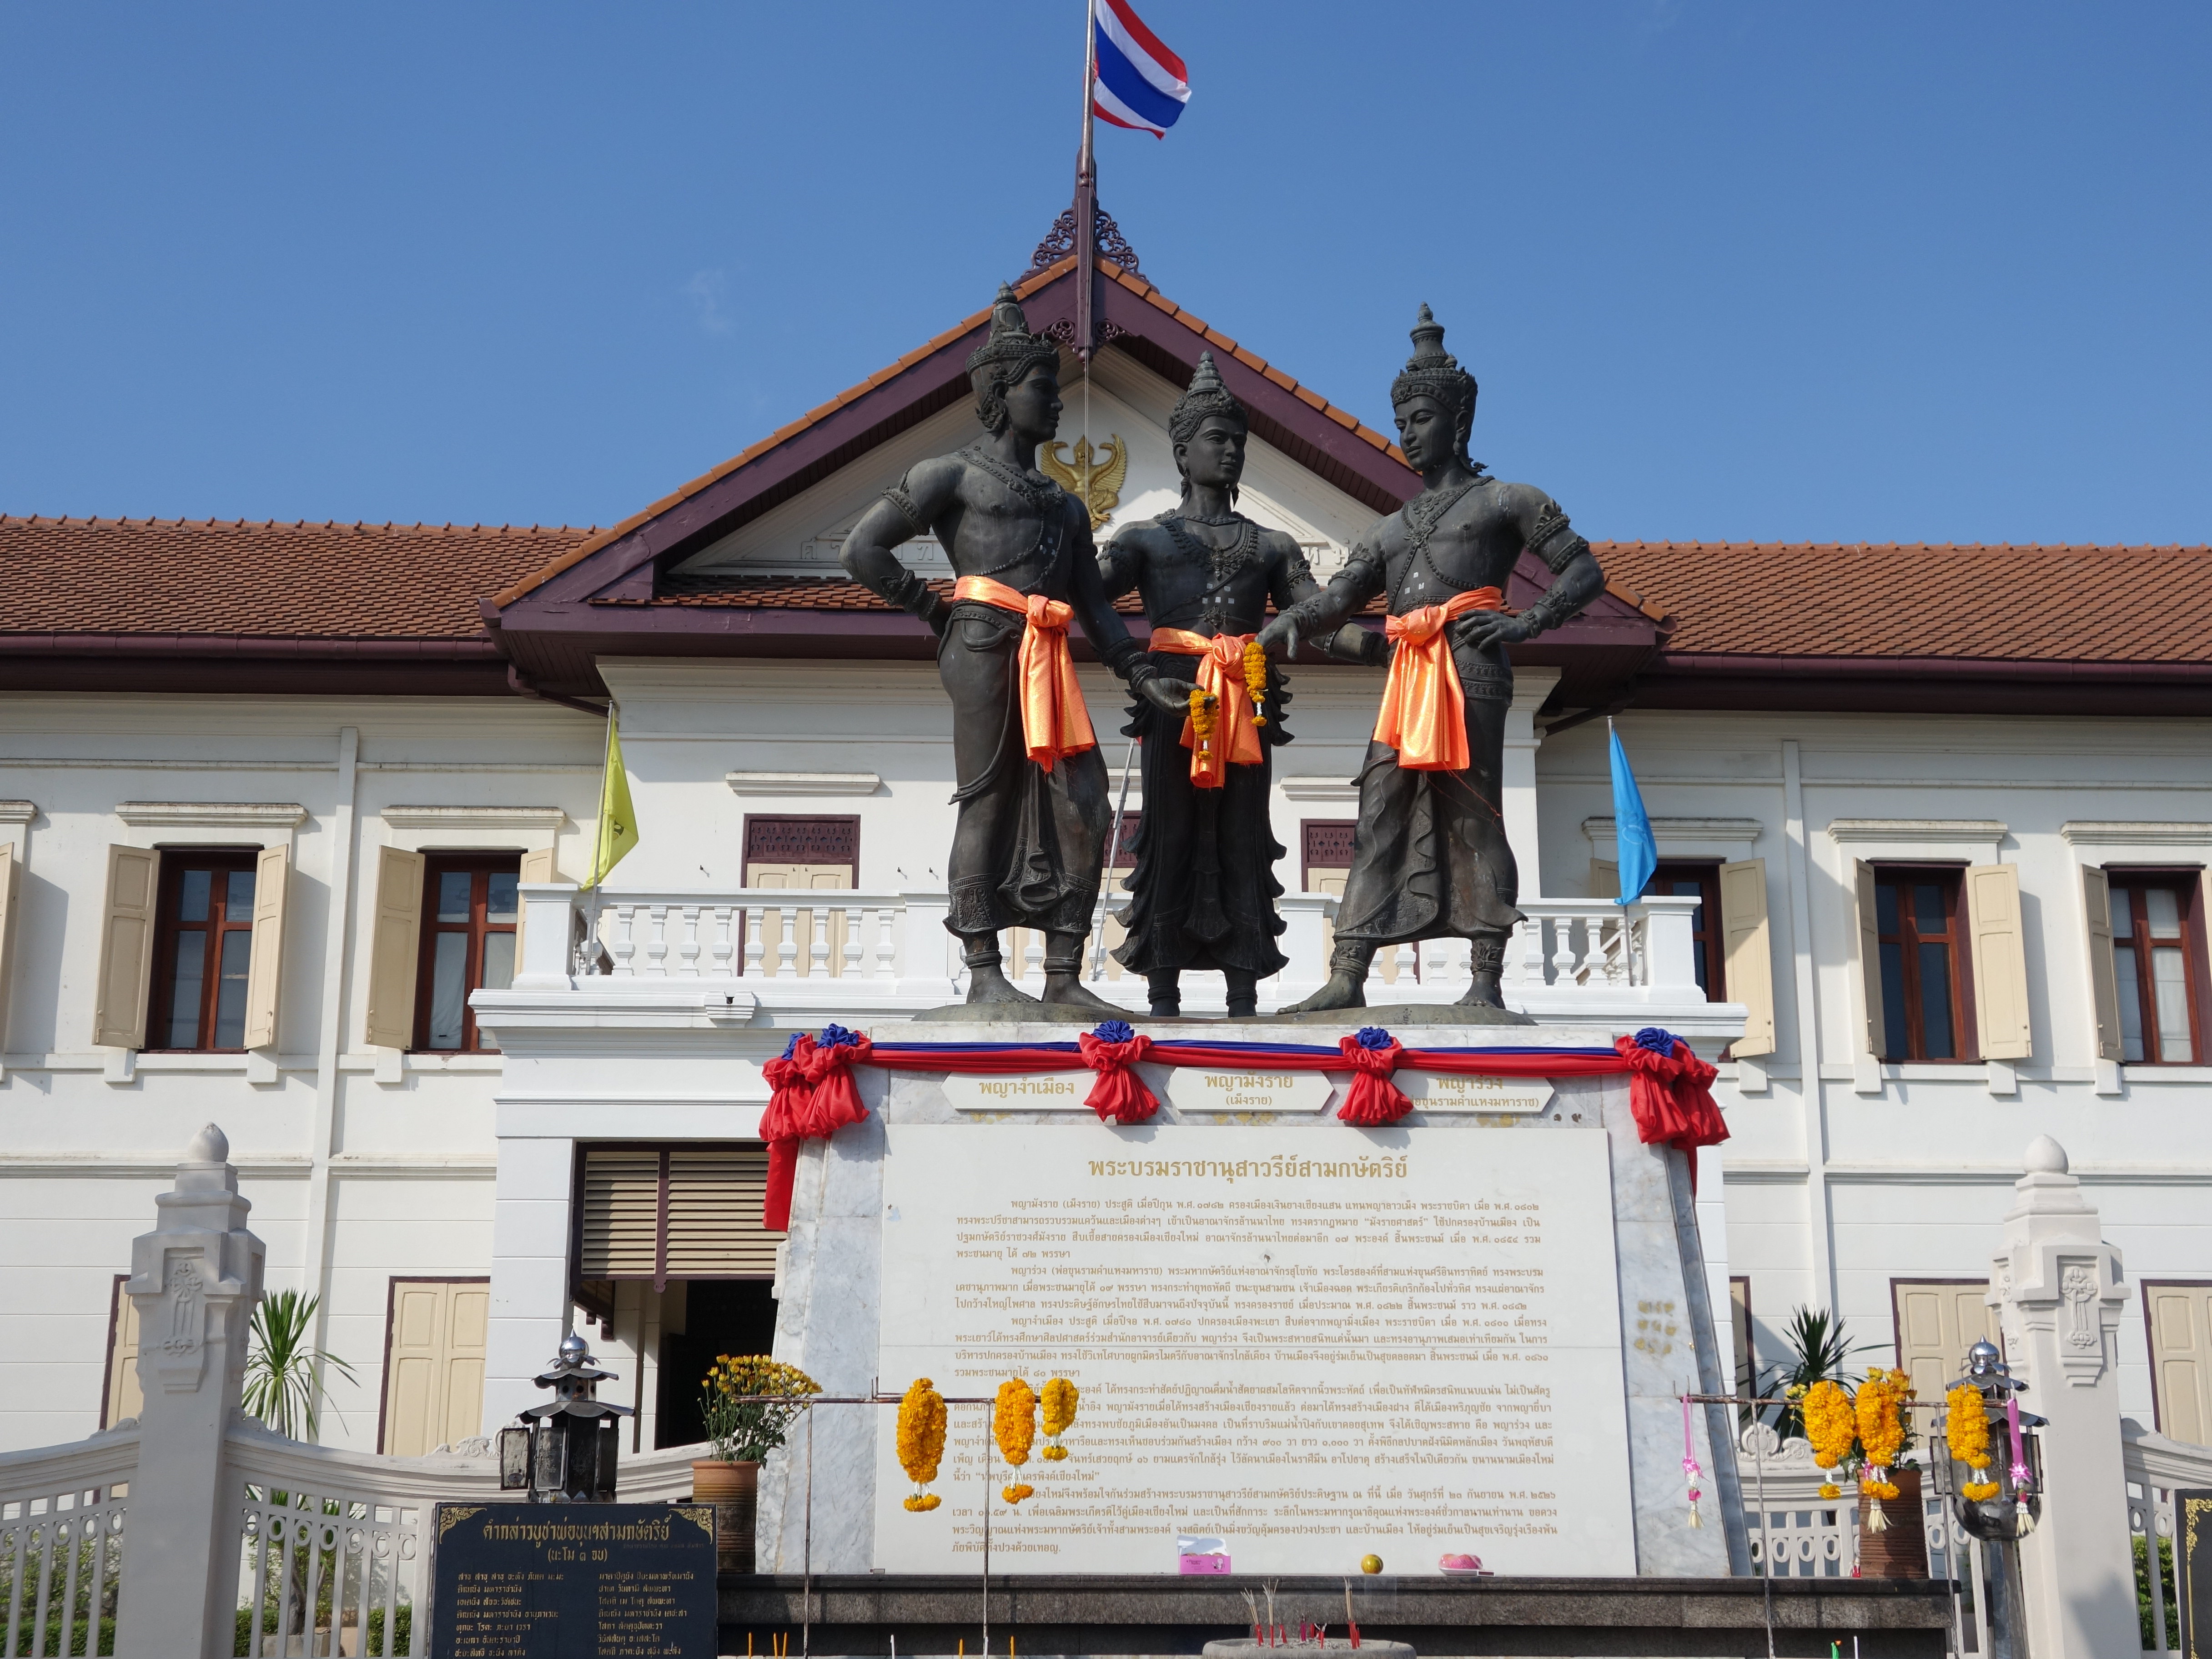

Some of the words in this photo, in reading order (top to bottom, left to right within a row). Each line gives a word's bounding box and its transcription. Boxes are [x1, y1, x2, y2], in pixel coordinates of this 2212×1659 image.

[979, 1077, 1075, 1098] พญางำเมือง
[1205, 1070, 1294, 1091] พญามังราย
[1226, 1092, 1272, 1106] (เม็งราย)
[1411, 1094, 1539, 1109] ่อขุนรามคำแหงมหาราช)
[1088, 1154, 1408, 1184] พระบรมราชานุสาวรีย์สามกษัตริย์
[1010, 1198, 1059, 1210] พญามังราย
[1063, 1197, 1101, 1209] (เม็งราย)
[1104, 1198, 1133, 1212] ประสูติ
[1137, 1196, 1173, 1212] เมื่อปีกุน
[1176, 1201, 1195, 1209] พ.ศ.
[1345, 1199, 1416, 1212] แทนพญาลาวเม็ง
[1420, 1200, 1470, 1210] พระราชบิดา
[1474, 1198, 1490, 1210] เมื่อ
[1493, 1202, 1513, 1211] พ.ศ.
[1290, 1218, 1358, 1229] ทรงตรากฎหมาย
[1364, 1216, 1428, 1227] “มังรายศาสตร์”
[1523, 1217, 1541, 1227] เป็น
[1354, 1232, 1389, 1243] พระองค์
[1394, 1230, 1444, 1243] สิ้นพระชนม์
[1450, 1230, 1466, 1243] เมื่อ
[1472, 1235, 1491, 1243] พ.ศ.
[956, 1250, 1002, 1261] พระชนมายุ
[1006, 1247, 1018, 1258] ได้
[1010, 1264, 1046, 1277] พญาร่วง
[955, 1283, 1018, 1295] เดชานุภาพมาก
[1235, 1284, 1296, 1296] ชนะขุนสามชน
[1299, 1282, 1352, 1293] เจ้าเมืองฉอด
[1474, 1283, 1544, 1293] ทรงแผ่อาณาจักร
[1234, 1298, 1294, 1309] ทรงครองราชย์
[1299, 1296, 1352, 1310] เมื่อประมาณ
[1355, 1301, 1374, 1310] พ.ศ.
[1408, 1296, 1456, 1310] สิ้นพระชนม์
[1480, 1302, 1499, 1310] พ.ศ.
[1010, 1314, 1063, 1328] พญางำเมือง
[1068, 1315, 1097, 1328] ประสูติ
[1103, 1312, 1137, 1326] เมื่อปีจอ
[1142, 1317, 1161, 1326] พ.ศ.
[1385, 1316, 1436, 1327] พระราชบิดา
[1441, 1313, 1457, 1327] เมื่อ
[1462, 1318, 1481, 1327] พ.ศ.
[1514, 1314, 1547, 1327] เมื่อทรง
[1201, 1332, 1237, 1345] พญาร่วง
[1518, 1332, 1548, 1344] ในการ
[1430, 1349, 1478, 1361] สิ้นพระชนม์
[1483, 1349, 1498, 1361] เมื่อ
[1502, 1352, 1521, 1361] พ.ศ.
[954, 1365, 1029, 1377] รวมพระชนมายได้
[1051, 1369, 1081, 1378] พรรษา
[1504, 1383, 1550, 1398] ไม่เป็นศัตรู
[1496, 1399, 1551, 1415] จากพญายี่บา
[1475, 1418, 1488, 1429] คือ
[1493, 1419, 1530, 1432] พญาร่วง
[1237, 1435, 1257, 1446] กว้าง
[1353, 1438, 1363, 1447] วา
[1502, 1436, 1553, 1449] วันพฤหัสบดี
[953, 1452, 973, 1466] เพ็ญ
[1068, 1452, 1133, 1466] จันทร์เสวยฤกษ์
[1137, 1456, 1148, 1464] ๑๖
[1331, 1452, 1370, 1467] อาโปธาตุ
[953, 1467, 970, 1481] นี้ว่า
[1367, 1484, 1382, 1499] ที่นี้
[1386, 1485, 1402, 1499] เมื่อ
[1407, 1485, 1444, 1502] วันศุกร์ที่
[1467, 1488, 1504, 1499] กันยายน
[1508, 1490, 1528, 1499] พ.ศ.
[1530, 1491, 1556, 1499] ๒๕๒๖
[952, 1508, 972, 1517] เวลา
[978, 1508, 1007, 1517] ๑.๕๙
[1012, 1508, 1022, 1517] น.
[1528, 1508, 1557, 1517] ขอดวง
[1346, 1523, 1403, 1534] และบ้านเมือง
[548, 1547, 575, 1563] (นะโม
[591, 1550, 608, 1563] จบ)
